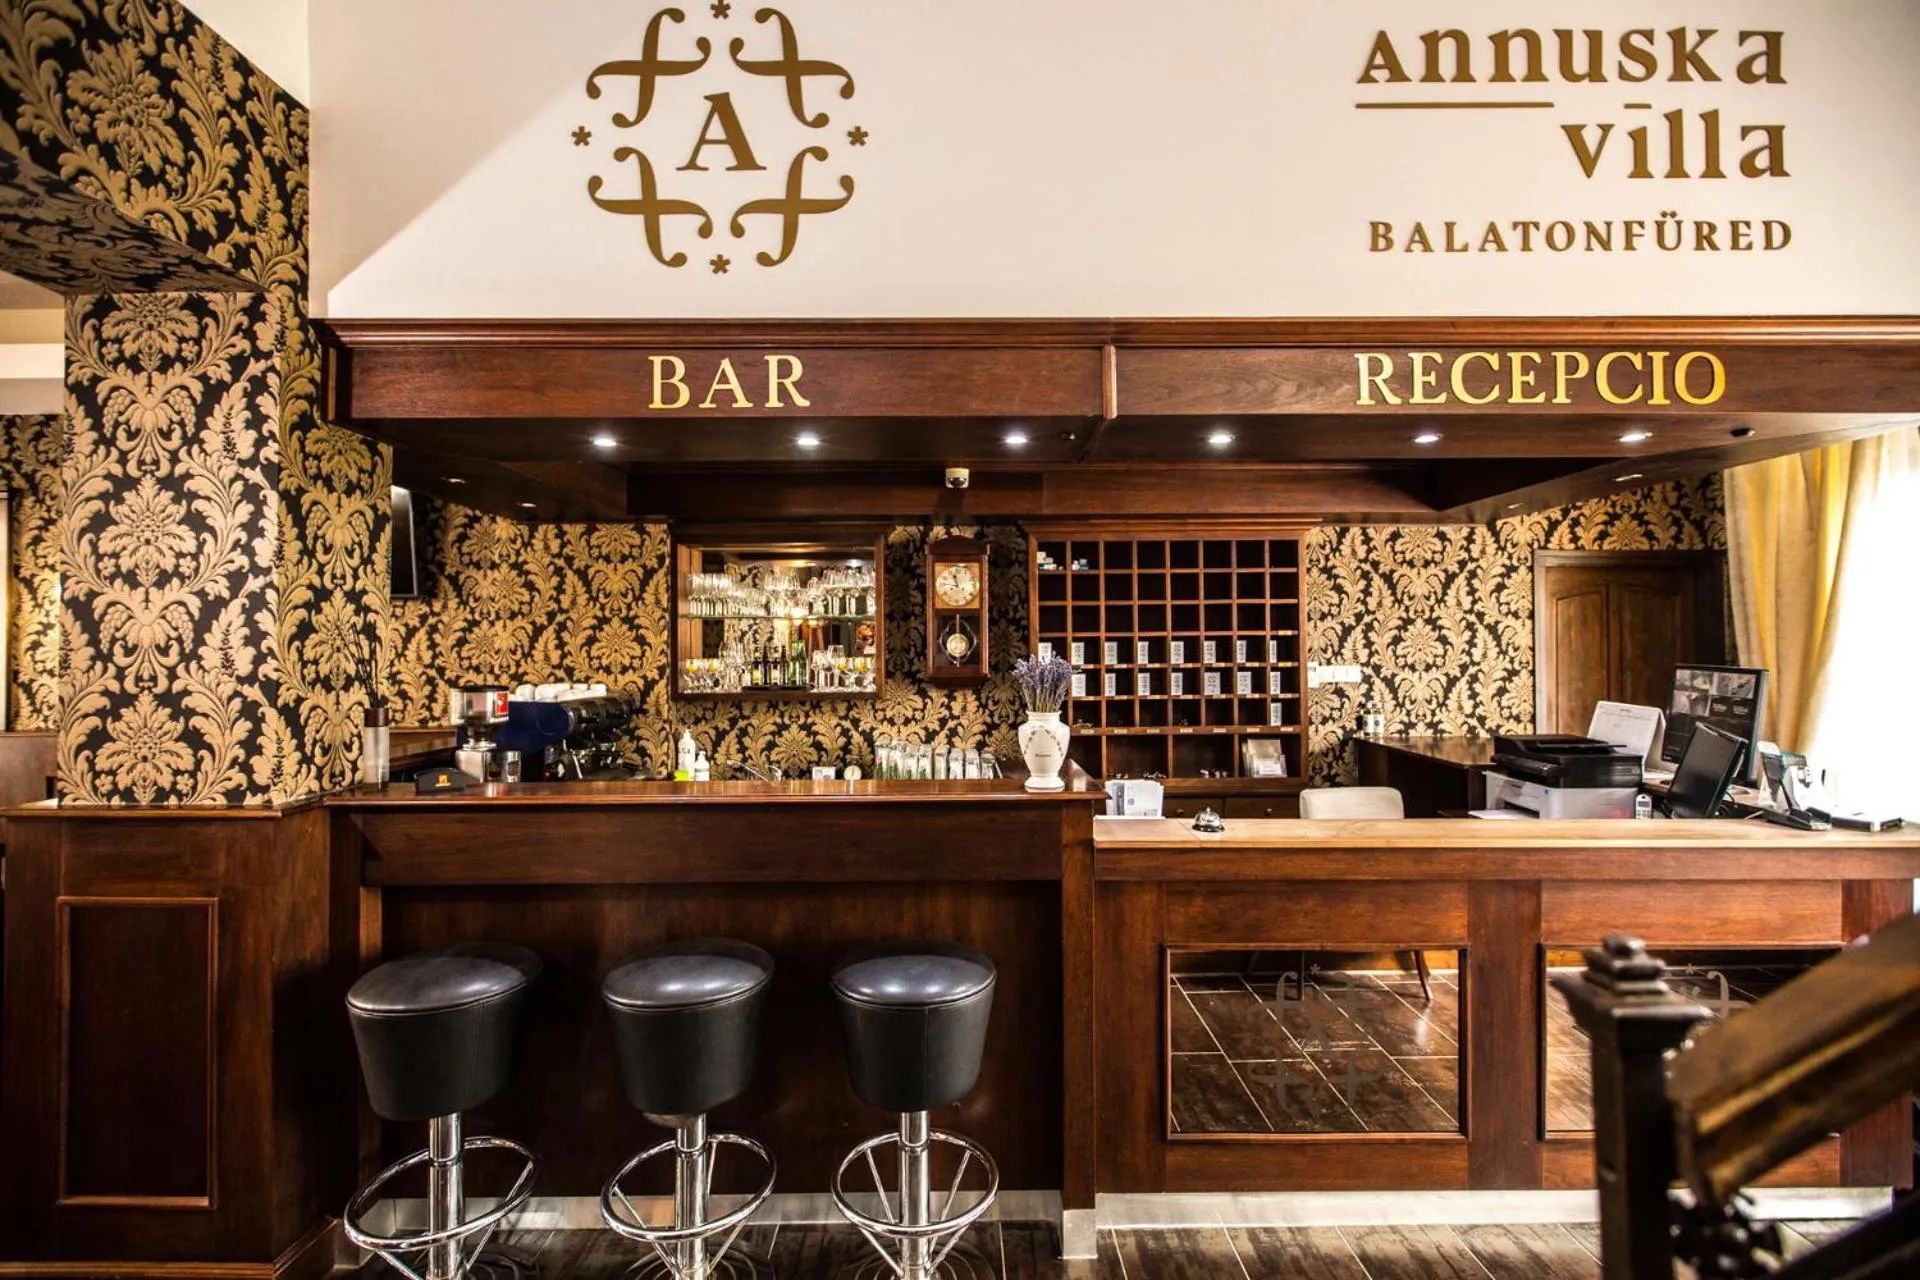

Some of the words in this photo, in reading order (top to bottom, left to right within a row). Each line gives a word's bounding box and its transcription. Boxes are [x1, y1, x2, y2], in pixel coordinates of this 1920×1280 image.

[675, 91, 767, 171] A
[1369, 210, 1792, 253] BALATONFÜRED
[647, 354, 812, 409] BAR
[1354, 351, 1727, 406] RECEPCIO
